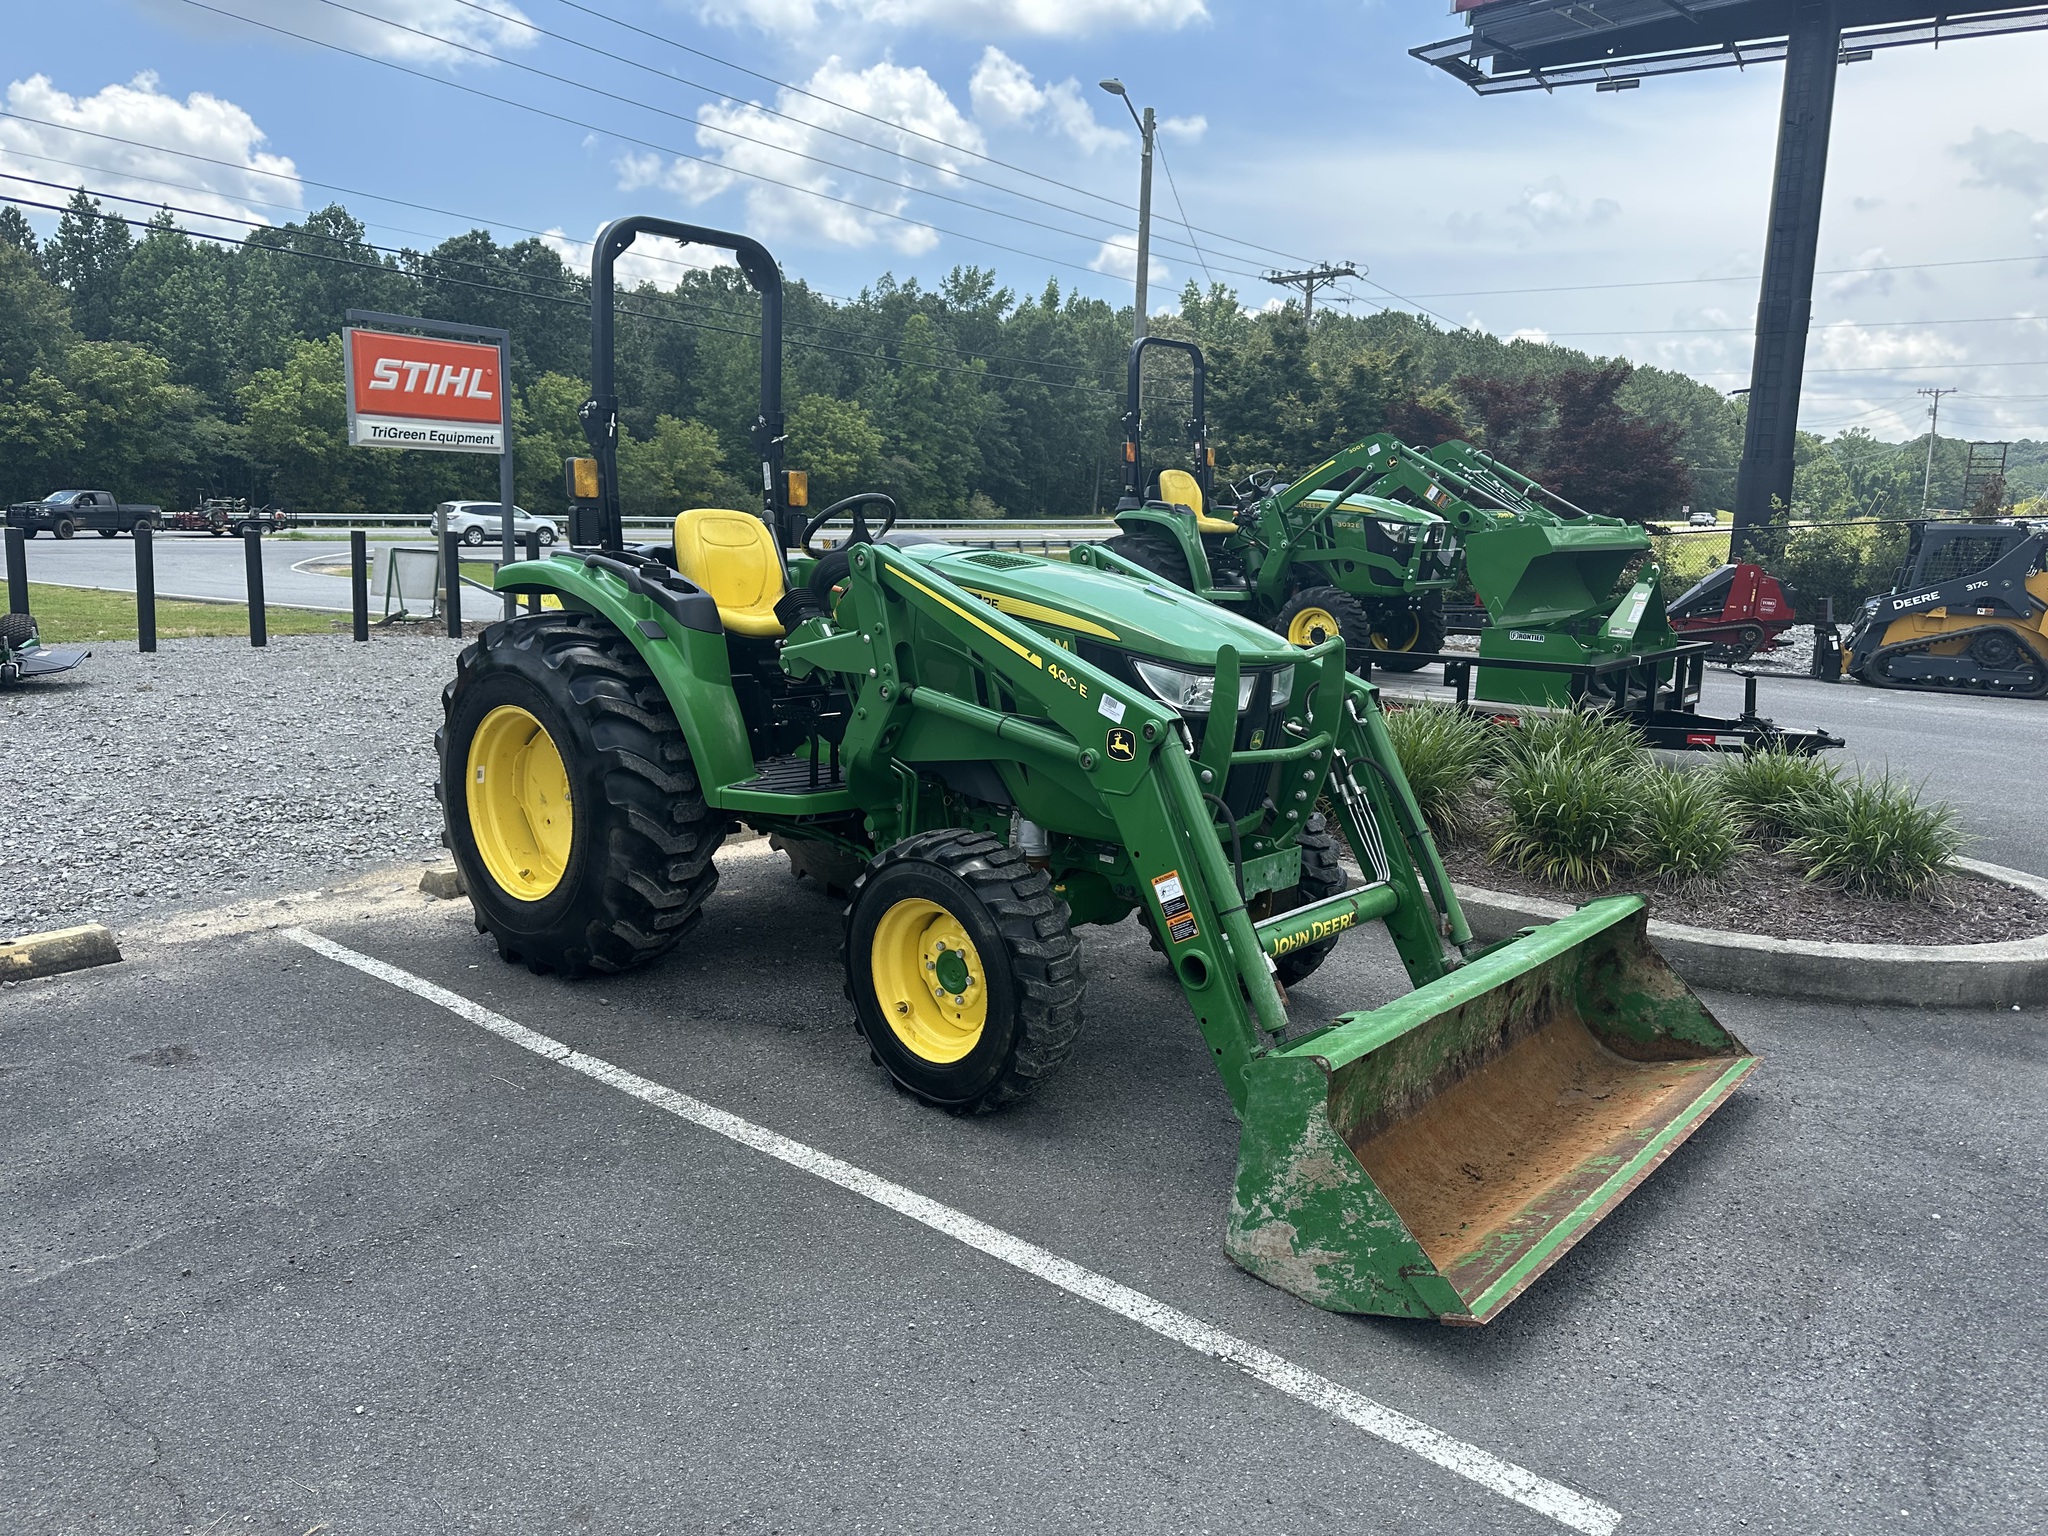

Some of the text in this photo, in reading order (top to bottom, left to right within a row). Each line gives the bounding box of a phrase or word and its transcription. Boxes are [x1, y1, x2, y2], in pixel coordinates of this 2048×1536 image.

[369, 358, 493, 400] STIHL
[371, 426, 495, 445] TriGreen Equipment
[1336, 520, 1360, 529] 3032E
[1965, 580, 1989, 592] 317G
[1892, 590, 1941, 610] DEERE
[1510, 630, 1544, 642] FRONTIER
[1269, 929, 1310, 958] JOHN
